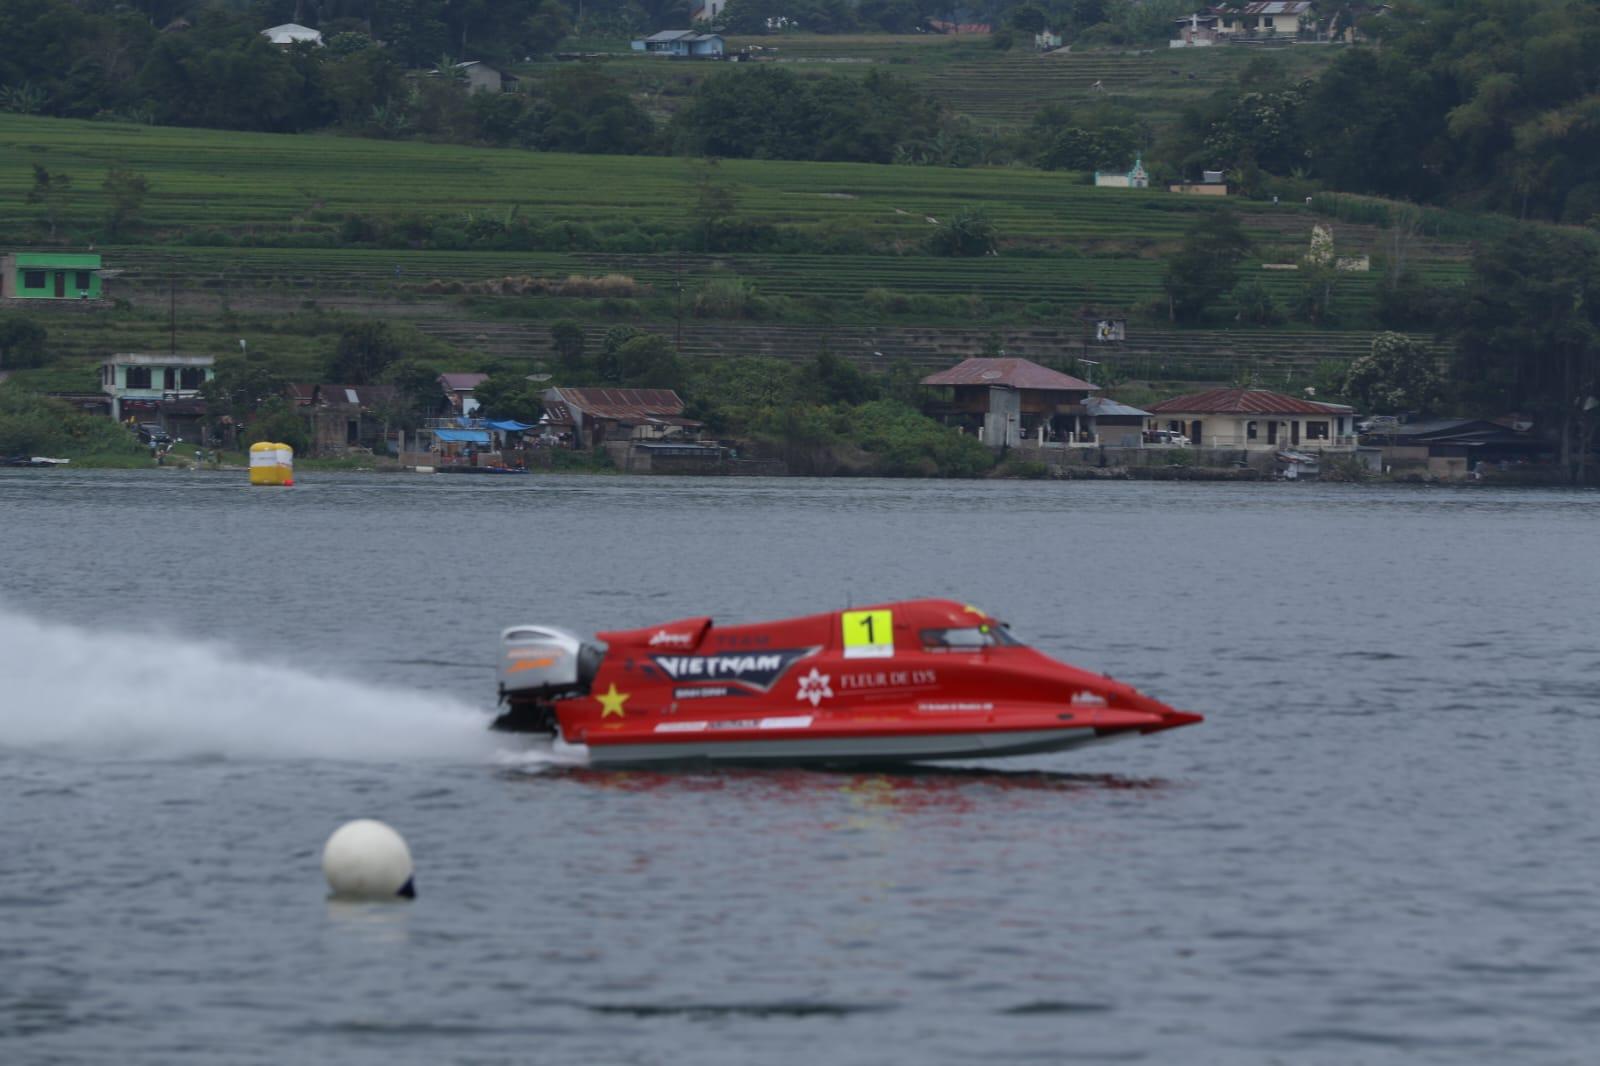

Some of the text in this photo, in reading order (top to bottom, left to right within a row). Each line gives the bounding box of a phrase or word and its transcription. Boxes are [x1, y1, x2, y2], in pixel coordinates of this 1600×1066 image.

[859, 613, 875, 644] 1
[655, 654, 783, 678] VIETNAM
[840, 669, 936, 689] FLEUR DE LYS
